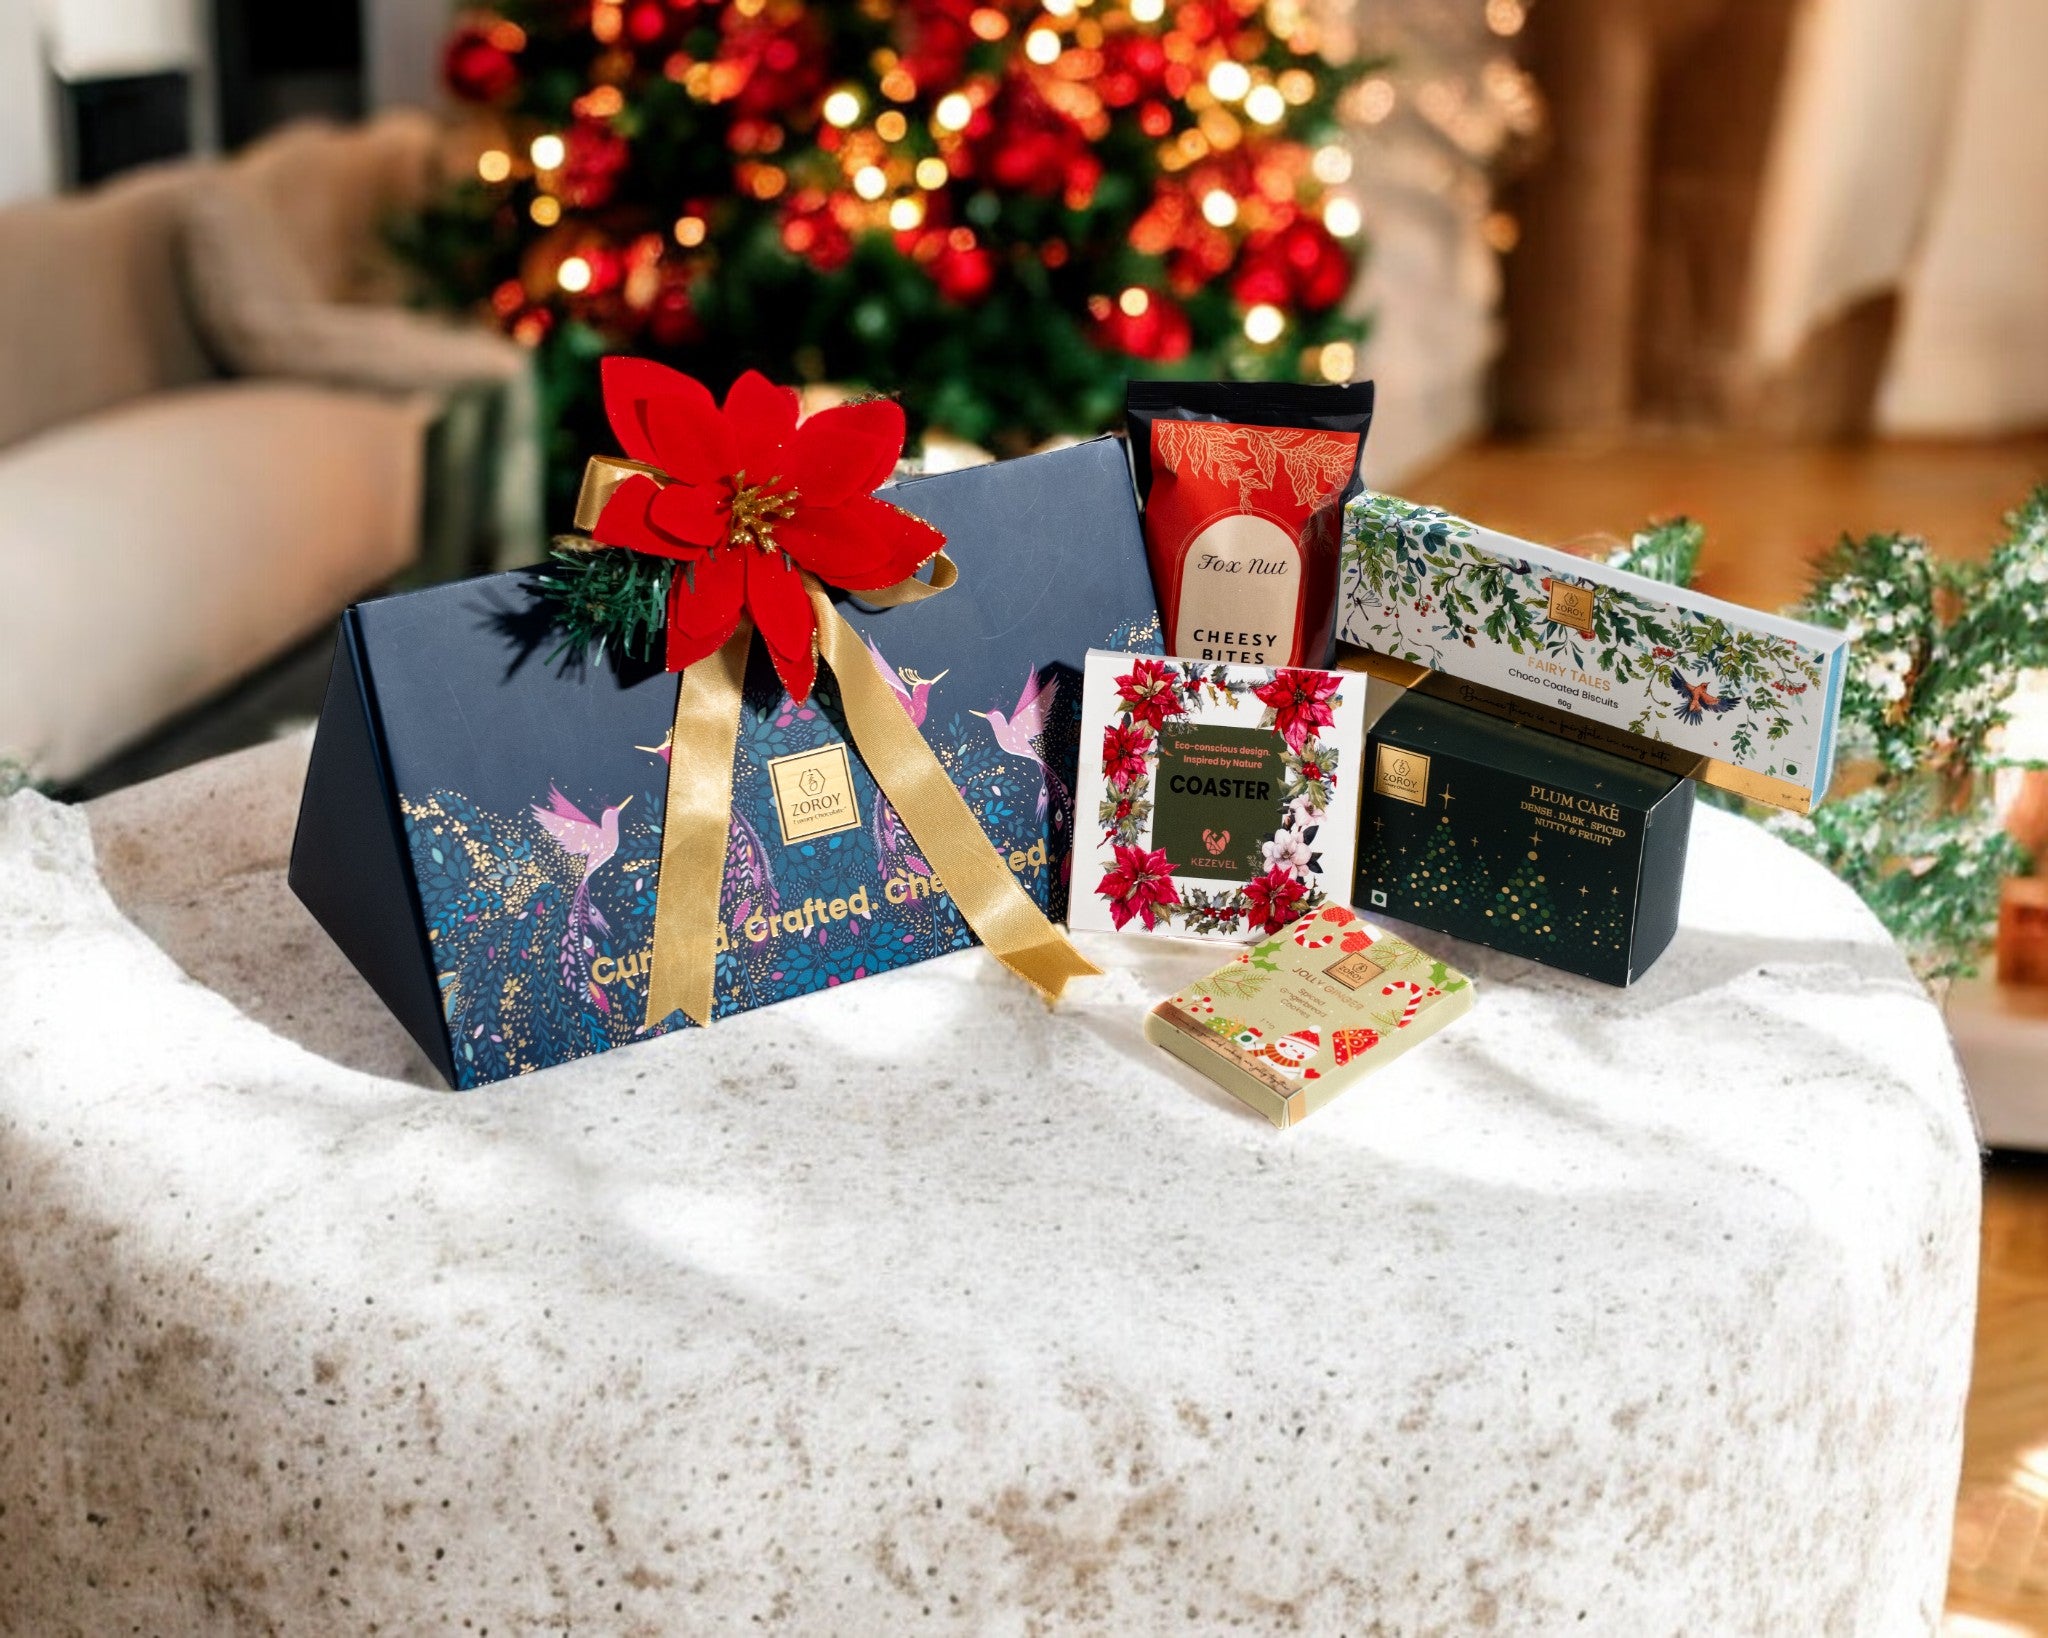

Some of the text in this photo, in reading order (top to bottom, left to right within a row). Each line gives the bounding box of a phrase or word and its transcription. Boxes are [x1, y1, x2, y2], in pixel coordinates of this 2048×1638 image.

[1197, 554, 1288, 575] Fox Nut
[1555, 603, 1585, 617] ZOROY
[1193, 629, 1277, 647] CHEESY
[1202, 648, 1264, 665] BITES
[1527, 656, 1611, 691] FAIRY TALES
[1508, 668, 1619, 709] Choco Coated Biscuits
[1557, 698, 1572, 710] 60g
[1174, 740, 1271, 758] Eco-conscious design.
[1183, 755, 1263, 769] Inspired by Nature
[1169, 774, 1270, 800] COASTER
[1383, 772, 1418, 788] ZOROY
[791, 793, 841, 816] ZOROY
[1529, 785, 1620, 822] PLUM CAKE
[1520, 801, 1626, 838] DENSE DARK SPICED
[1534, 817, 1613, 846] NUTTY & FRUITY
[1191, 857, 1238, 870] KEZEVEL
[744, 885, 879, 942] Crafted.
[1338, 965, 1364, 981] ZOROY
[1291, 967, 1326, 985] JOLLY
[1323, 985, 1364, 1011] GINGER
